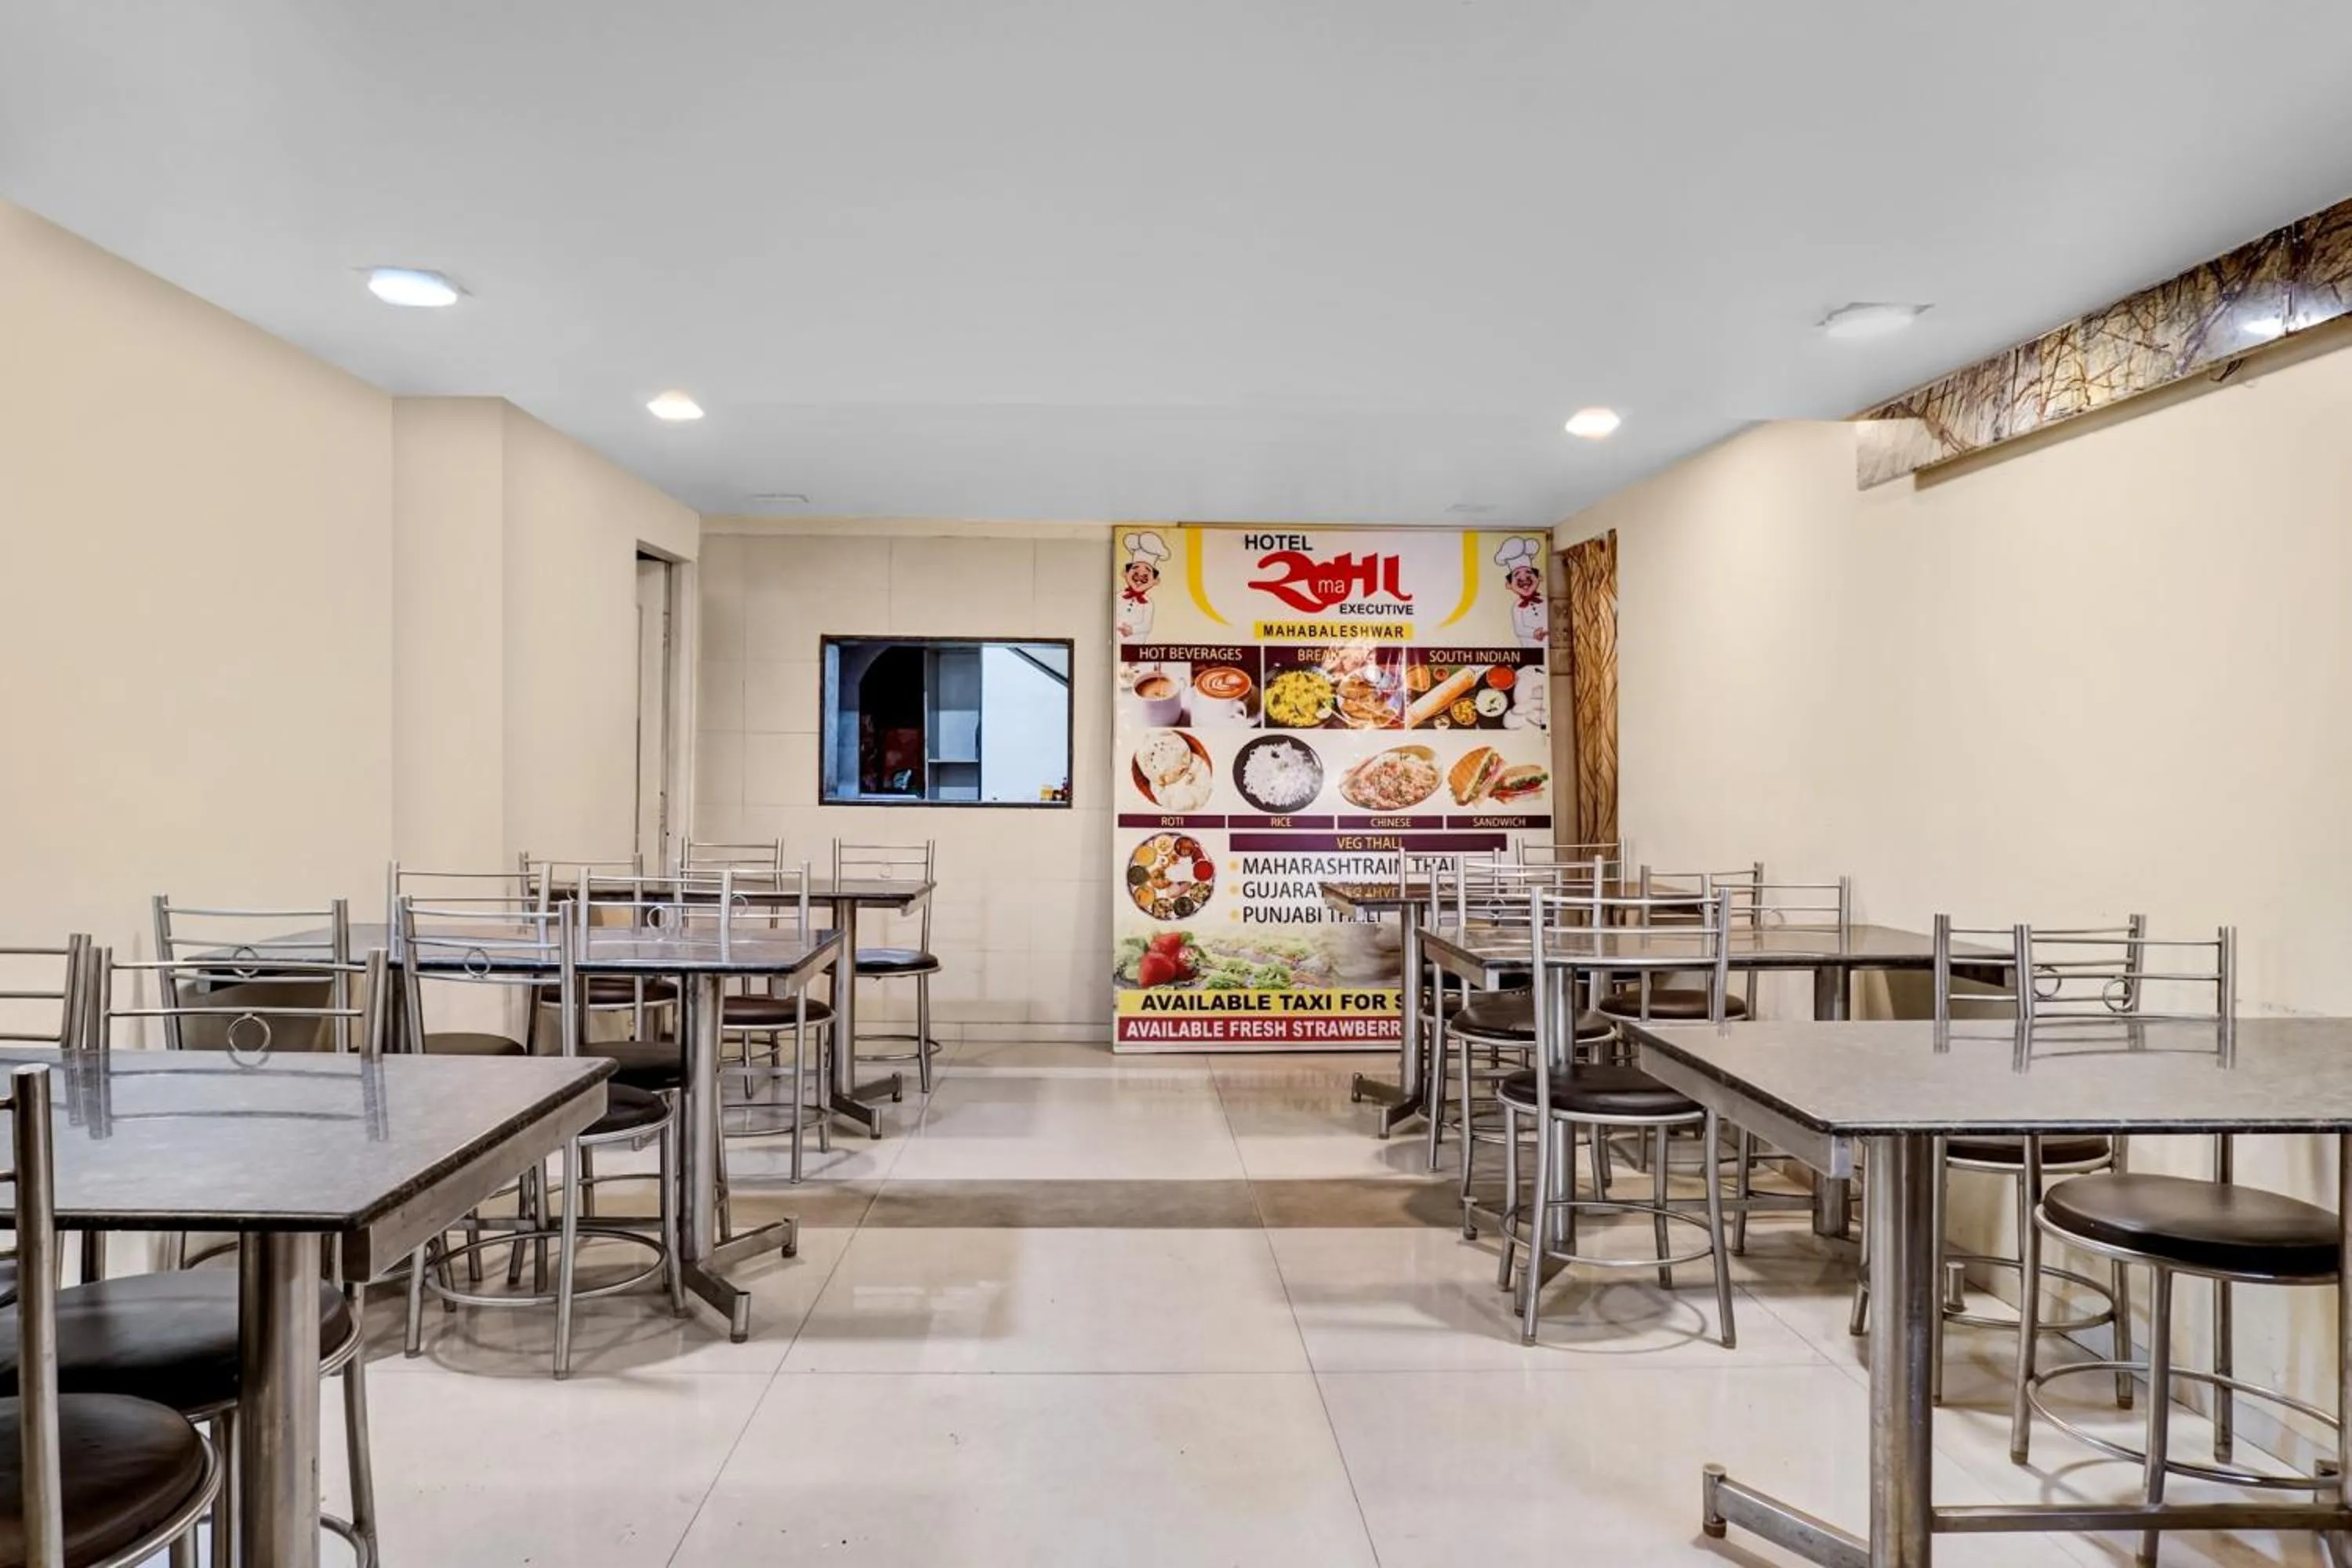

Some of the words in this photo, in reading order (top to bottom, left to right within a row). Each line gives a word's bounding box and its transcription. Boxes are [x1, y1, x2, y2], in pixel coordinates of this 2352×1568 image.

[1244, 534, 1313, 551] HOTEL
[1318, 579, 1345, 593] ma
[1339, 604, 1414, 615] EXECUTIVE
[1263, 624, 1404, 638] MAHABALESHWAR
[1139, 647, 1166, 659] HOT
[1169, 648, 1243, 661] BEVERAGES
[1429, 651, 1472, 663] SOUTH
[1475, 651, 1521, 663] INDIAN
[1161, 816, 1185, 827] ROTI
[1270, 816, 1293, 827] RICE
[1370, 817, 1412, 828] CHINESE
[1472, 816, 1526, 828] SANDWICH
[1336, 837, 1362, 849] VEG
[1243, 906, 1322, 924] PUNJABI
[1141, 994, 1271, 1011] AVAILABLE
[1279, 993, 1331, 1011] TAXI
[1341, 993, 1387, 1011] FOR
[1126, 1021, 1224, 1037] AVAILABLE
[1229, 1021, 1287, 1037] FRESH
[1293, 1020, 1402, 1037] STRAWBERR
